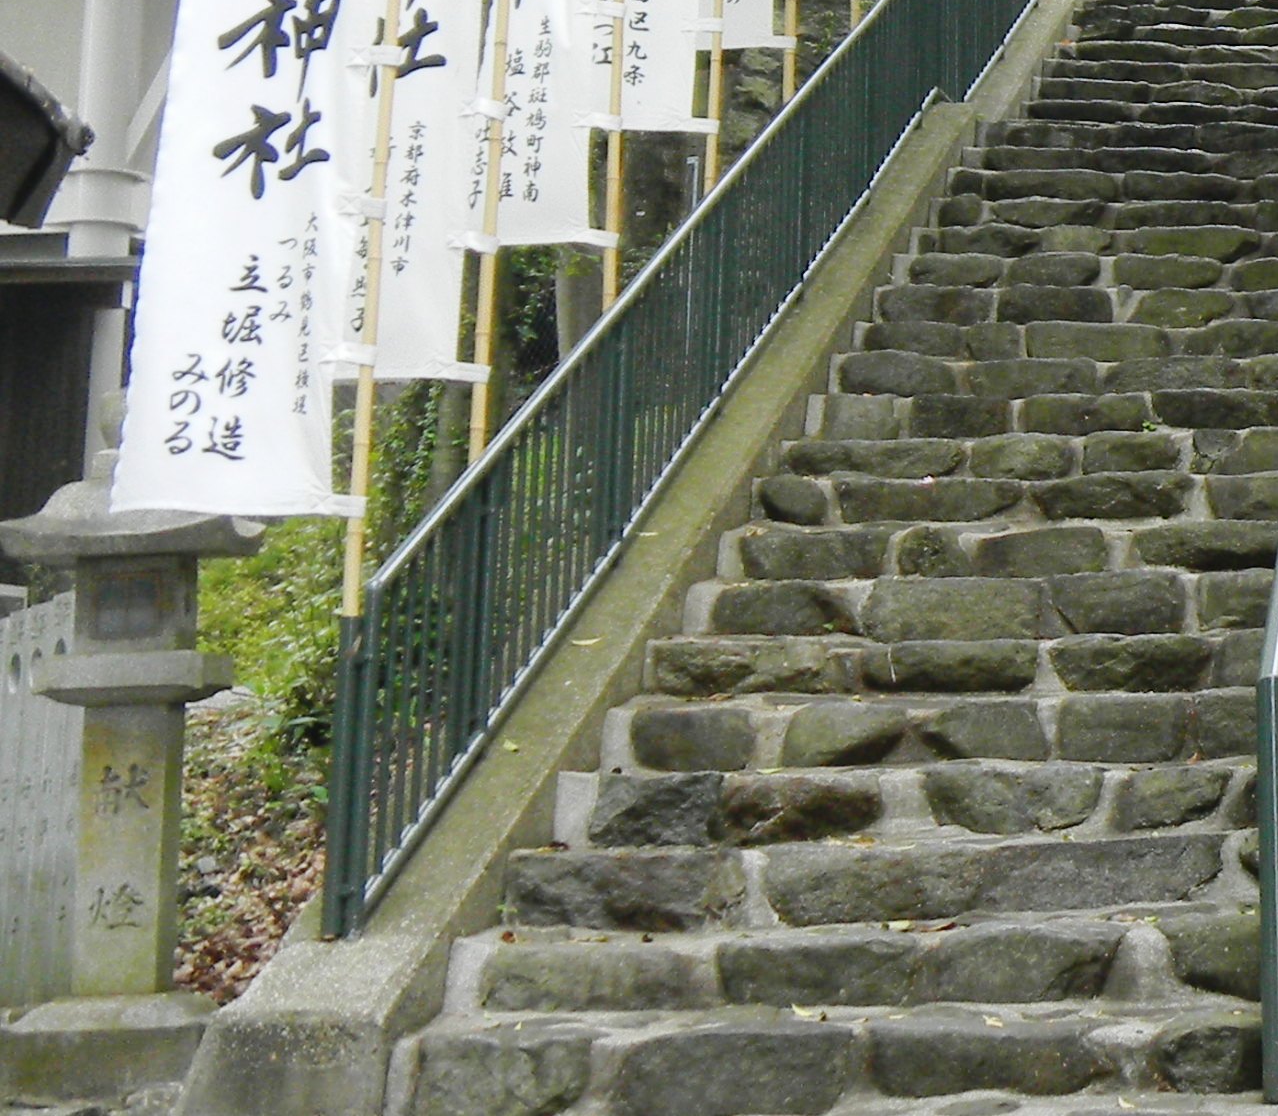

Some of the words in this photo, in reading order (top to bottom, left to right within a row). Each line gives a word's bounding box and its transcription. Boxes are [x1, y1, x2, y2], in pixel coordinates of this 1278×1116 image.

[522, 14, 553, 204] 生駒郡斑鳩町神南
[390, 120, 427, 277] 京都府木津川市
[201, 254, 268, 462] 立堀修造
[269, 236, 299, 323] つるみ
[164, 352, 210, 456] みのる
